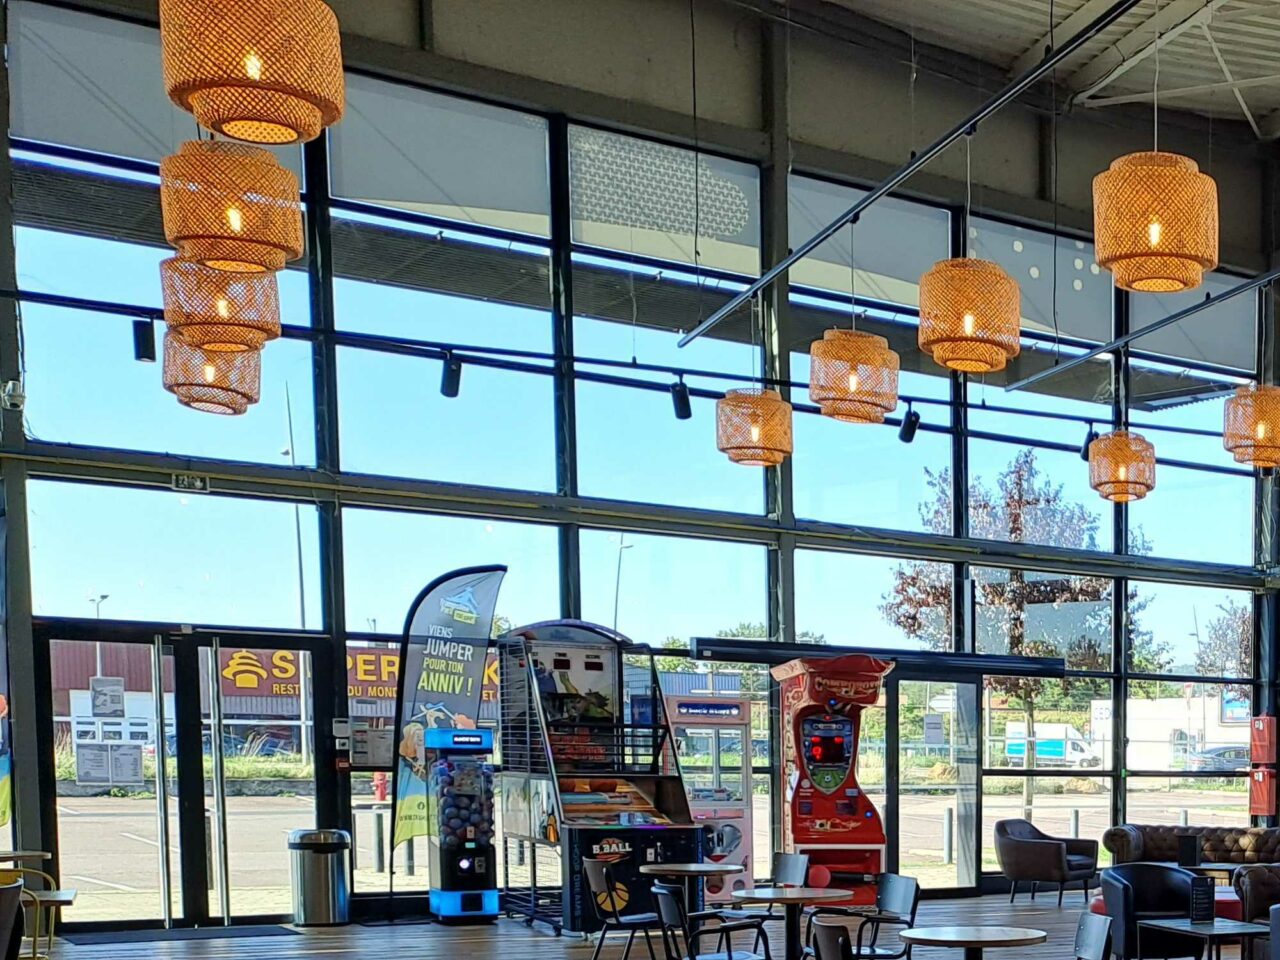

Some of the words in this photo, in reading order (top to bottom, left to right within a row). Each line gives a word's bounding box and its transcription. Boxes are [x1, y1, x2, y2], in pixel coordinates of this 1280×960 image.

[428, 624, 454, 638] VIENS
[422, 638, 474, 662] JUMPER
[423, 657, 447, 672] POUR
[448, 660, 465, 674] TON
[417, 670, 464, 695] ANNIV
